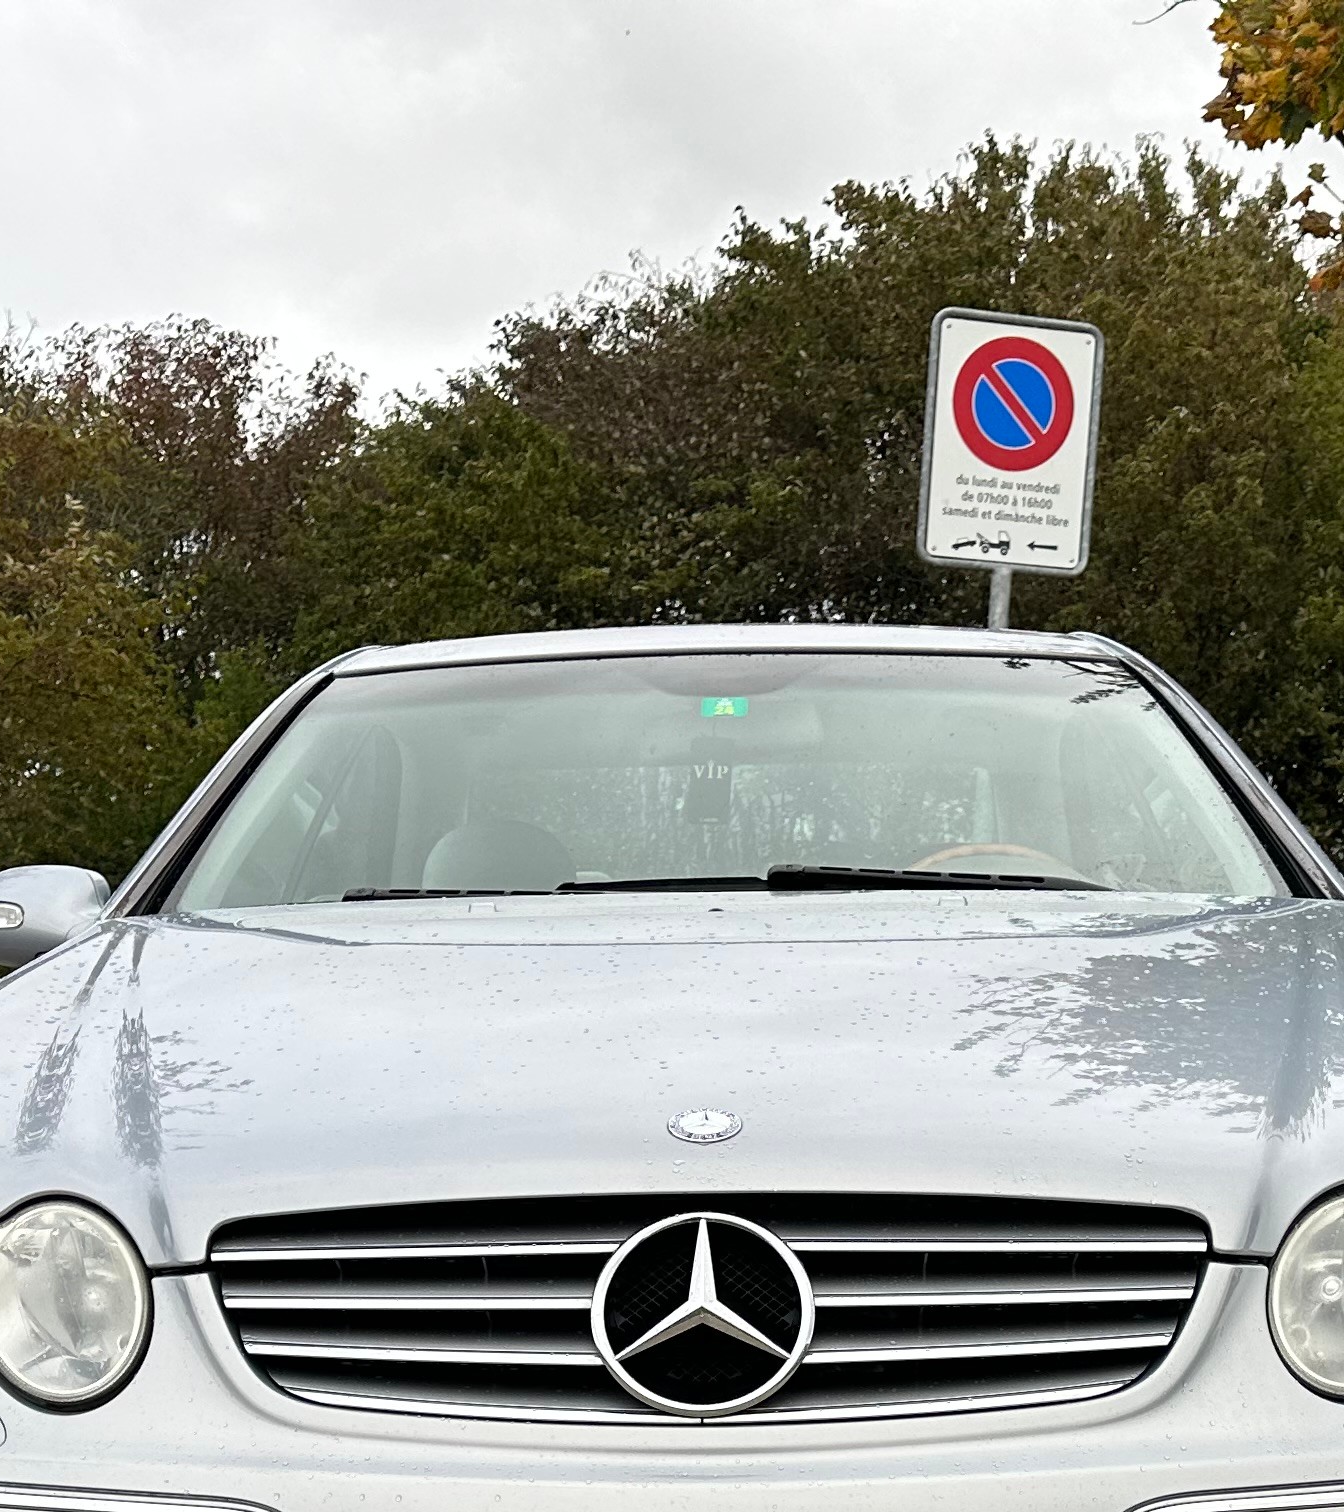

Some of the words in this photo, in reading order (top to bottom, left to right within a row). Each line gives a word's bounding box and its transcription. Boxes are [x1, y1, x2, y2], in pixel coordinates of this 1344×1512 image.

[956, 474, 969, 485] du
[972, 475, 998, 488] lundi
[1000, 480, 1013, 489] au
[1016, 482, 1061, 494] vendredi
[961, 490, 974, 502] de
[977, 492, 1009, 505] 07h00
[1021, 496, 1053, 509] 16h00
[942, 507, 979, 518] samedi
[981, 510, 992, 519] et
[994, 510, 1043, 525] dimanche
[1046, 514, 1069, 527] libre
[693, 763, 729, 779] VIP
